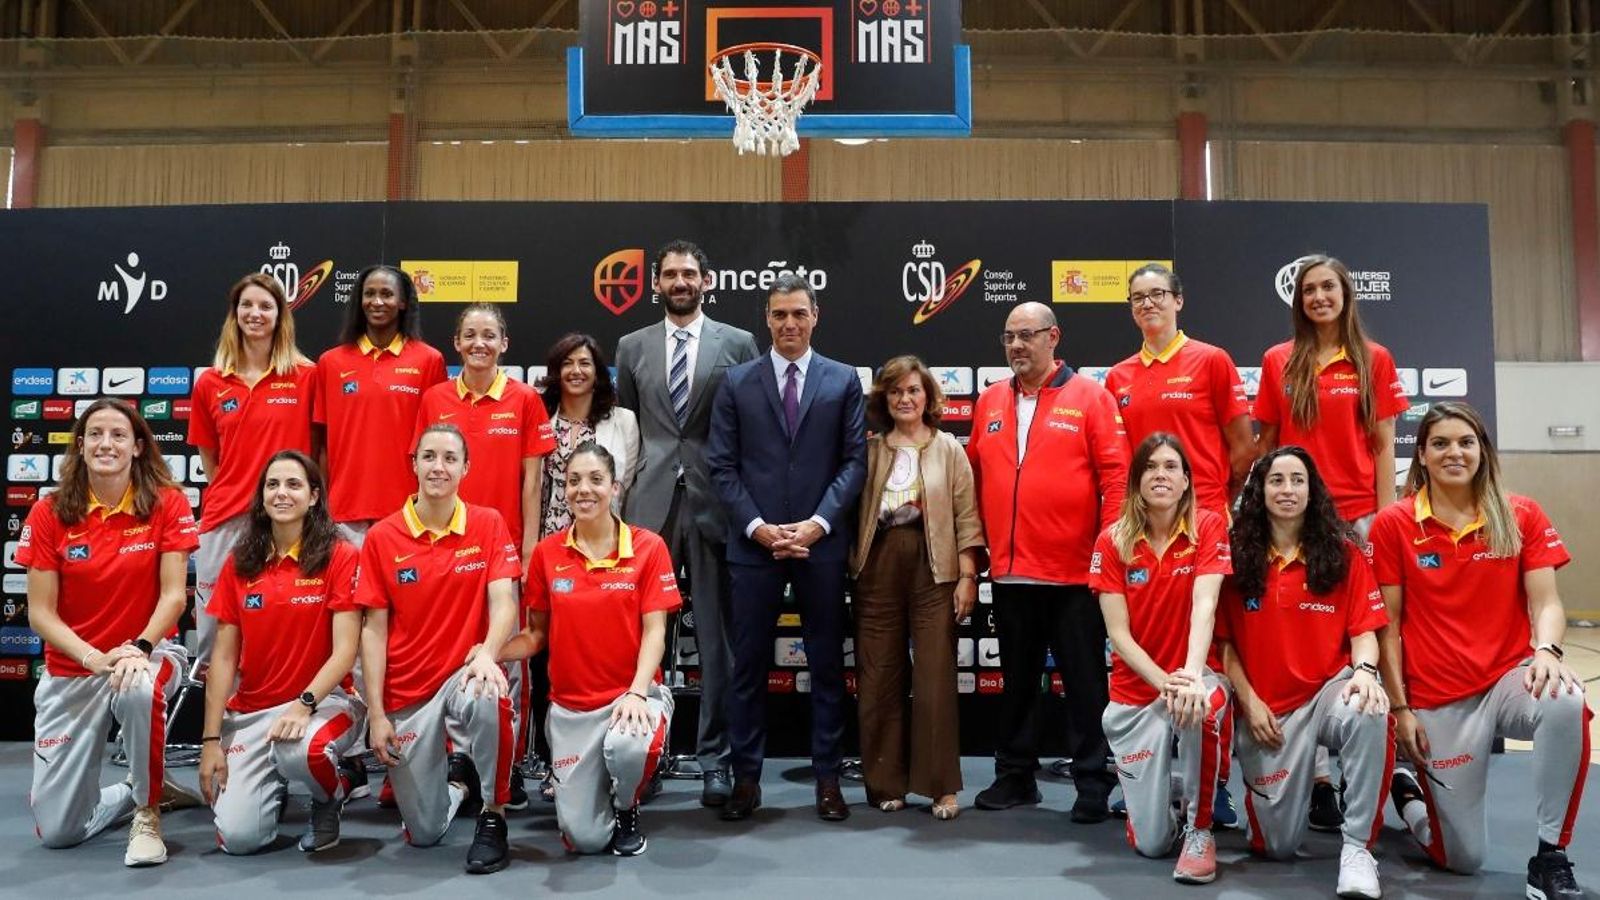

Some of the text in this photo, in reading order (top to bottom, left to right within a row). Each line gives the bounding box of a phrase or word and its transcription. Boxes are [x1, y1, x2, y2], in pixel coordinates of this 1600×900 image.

[984, 269, 1013, 281] Consejo
[1349, 271, 1391, 281] NIVERSO
[902, 261, 946, 303] CSD
[984, 280, 1027, 292] Superior de
[1354, 281, 1391, 292] UJER
[984, 292, 1018, 303] Deportes
[14, 376, 52, 385] endesa
[149, 376, 188, 385] endesa
[389, 385, 420, 395] endesa
[488, 426, 518, 435] endesa
[1, 635, 40, 645] endesa
[1432, 753, 1473, 770] ESPAÑA
